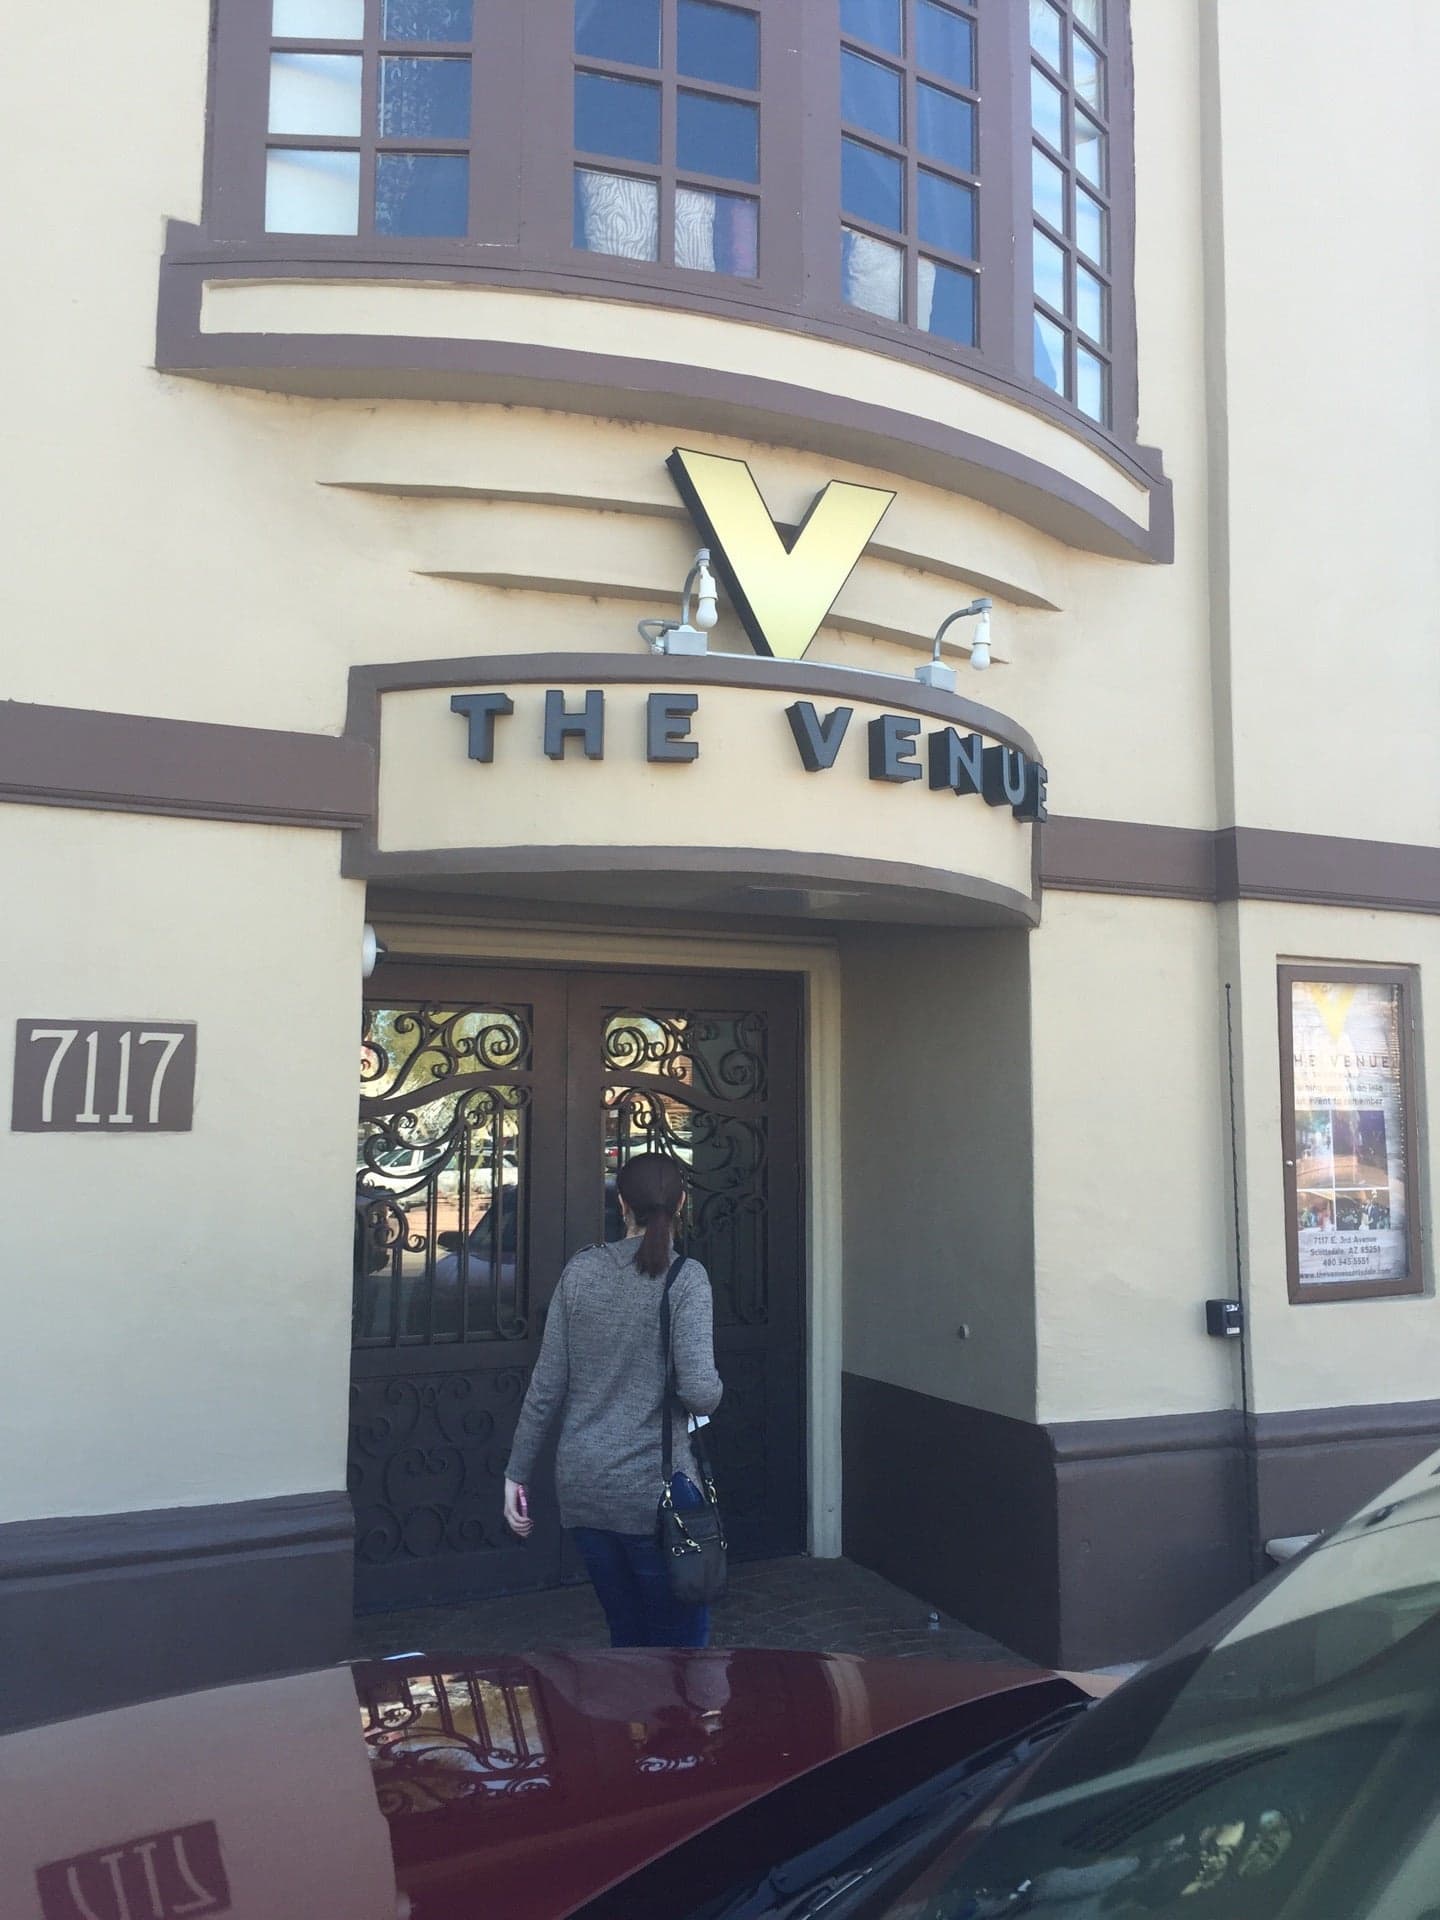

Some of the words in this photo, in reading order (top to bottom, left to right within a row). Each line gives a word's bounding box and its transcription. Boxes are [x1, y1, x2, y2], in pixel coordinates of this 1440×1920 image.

[665, 447, 897, 660] V
[450, 689, 699, 763] THE
[785, 700, 1049, 823] VENUE
[30, 1029, 185, 1124] 7117
[1294, 1054, 1316, 1067] HE
[1330, 1055, 1390, 1068] VENUE
[1314, 1236, 1328, 1245] 7117
[1348, 1246, 1358, 1254] AZ
